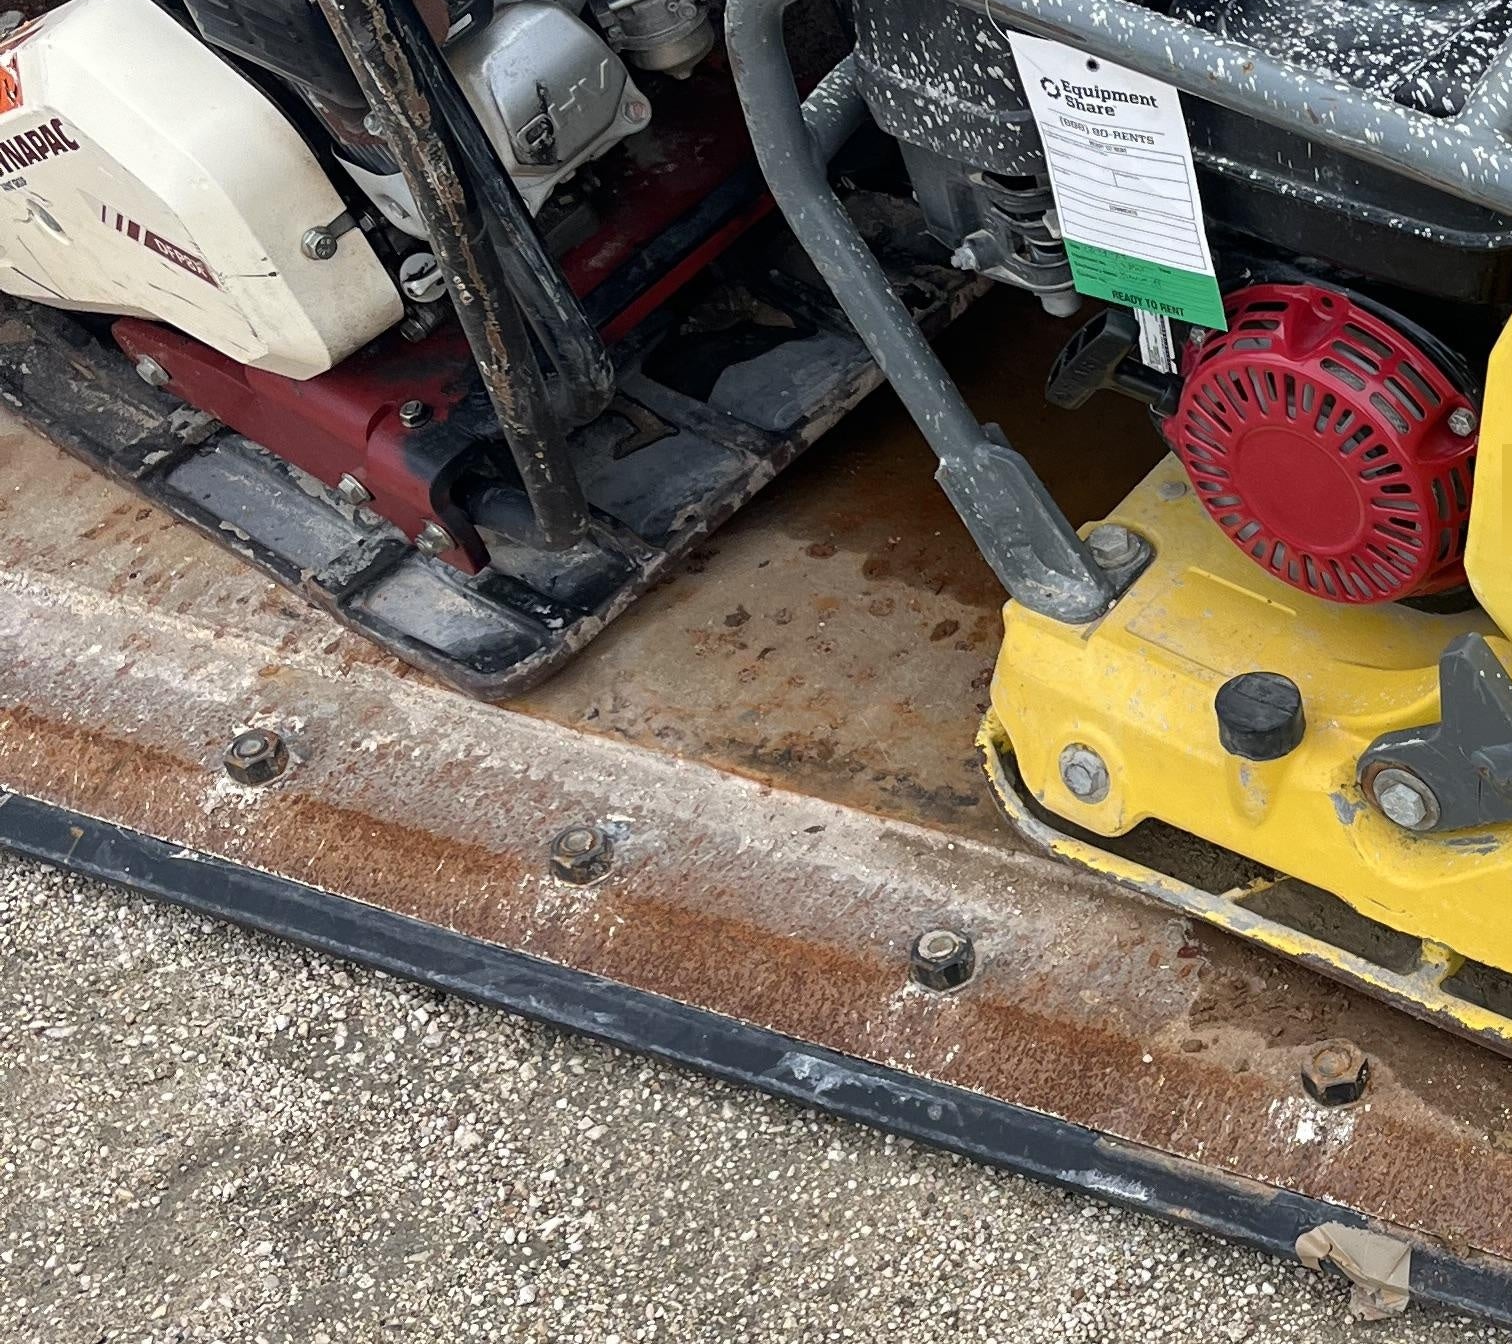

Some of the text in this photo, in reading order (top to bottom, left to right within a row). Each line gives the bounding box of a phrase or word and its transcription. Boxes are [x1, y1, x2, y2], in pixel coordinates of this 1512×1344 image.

[1060, 79, 1158, 108] Equipment
[1064, 94, 1116, 116] Share
[1112, 290, 1184, 317] READY TO RENT
